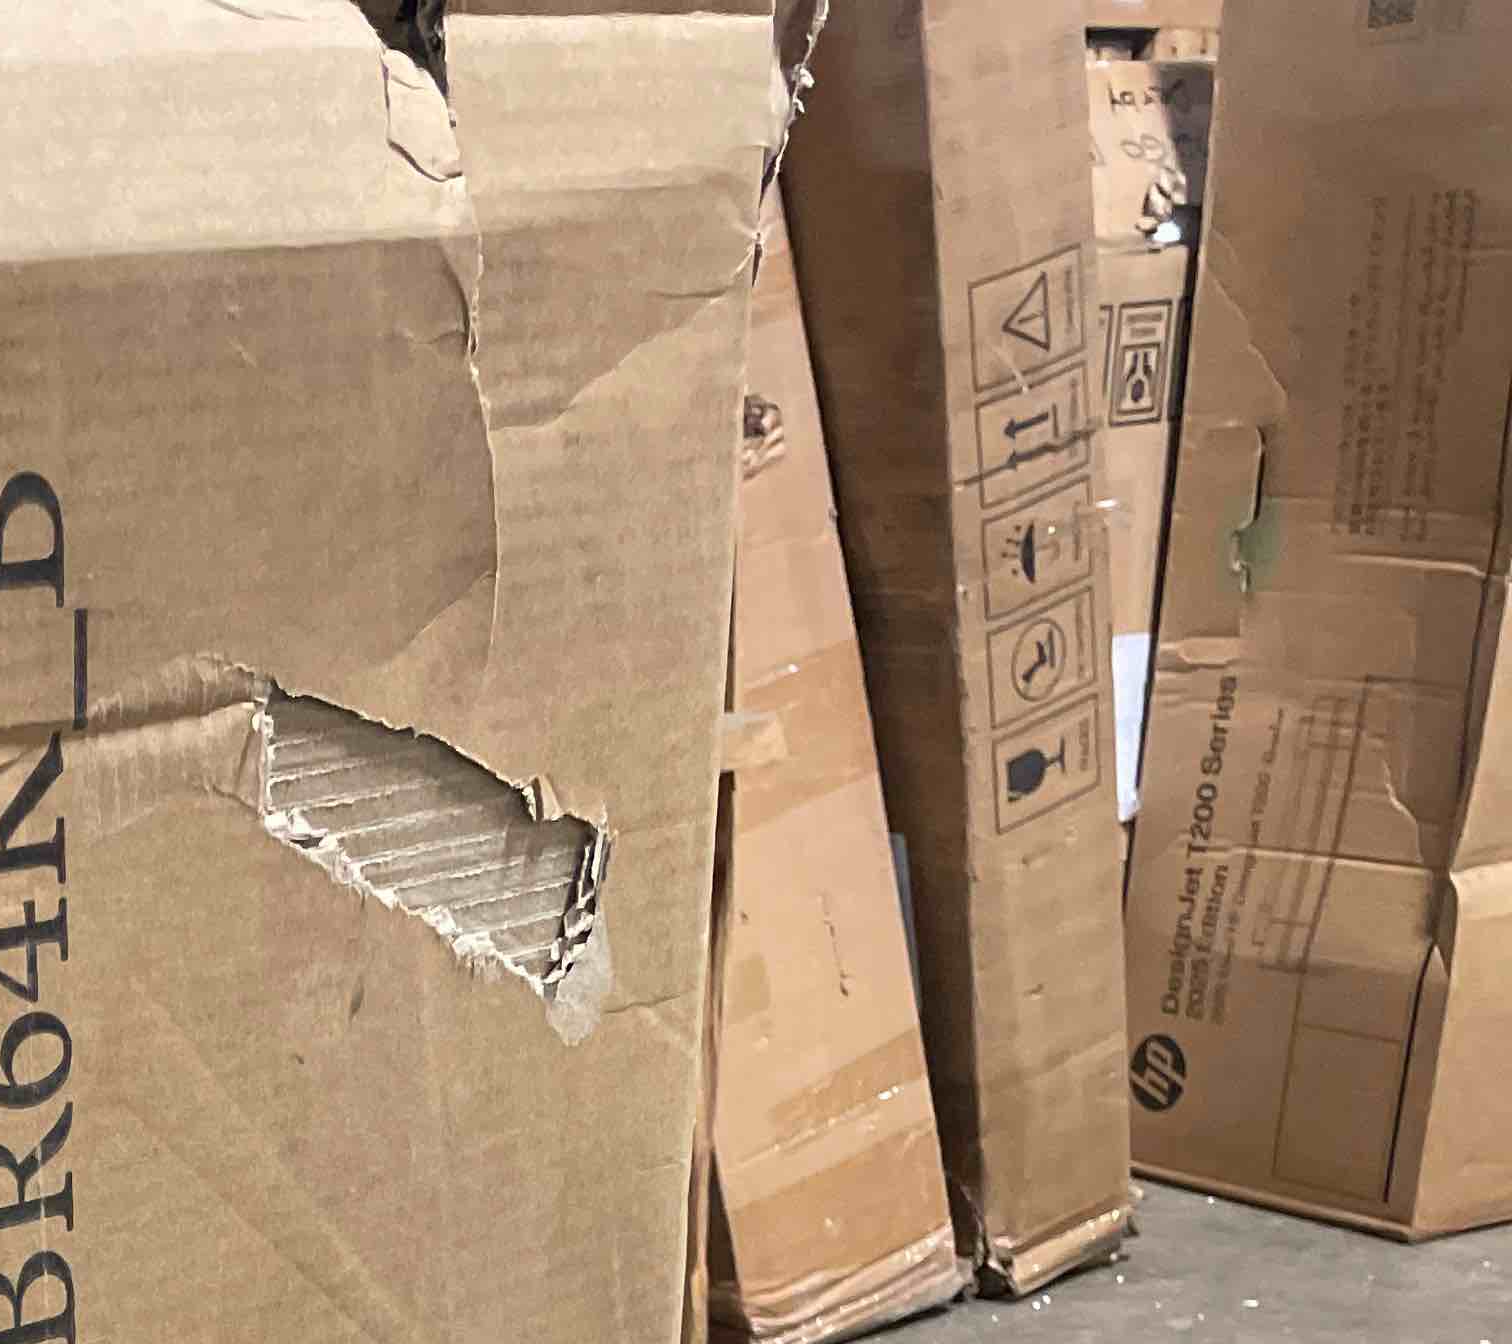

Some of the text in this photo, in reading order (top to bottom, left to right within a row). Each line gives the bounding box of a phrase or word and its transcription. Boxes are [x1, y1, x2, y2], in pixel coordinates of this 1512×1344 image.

[1160, 674, 1238, 1017] DesignJet T200 Series
[1130, 1033, 1187, 1113] hp
